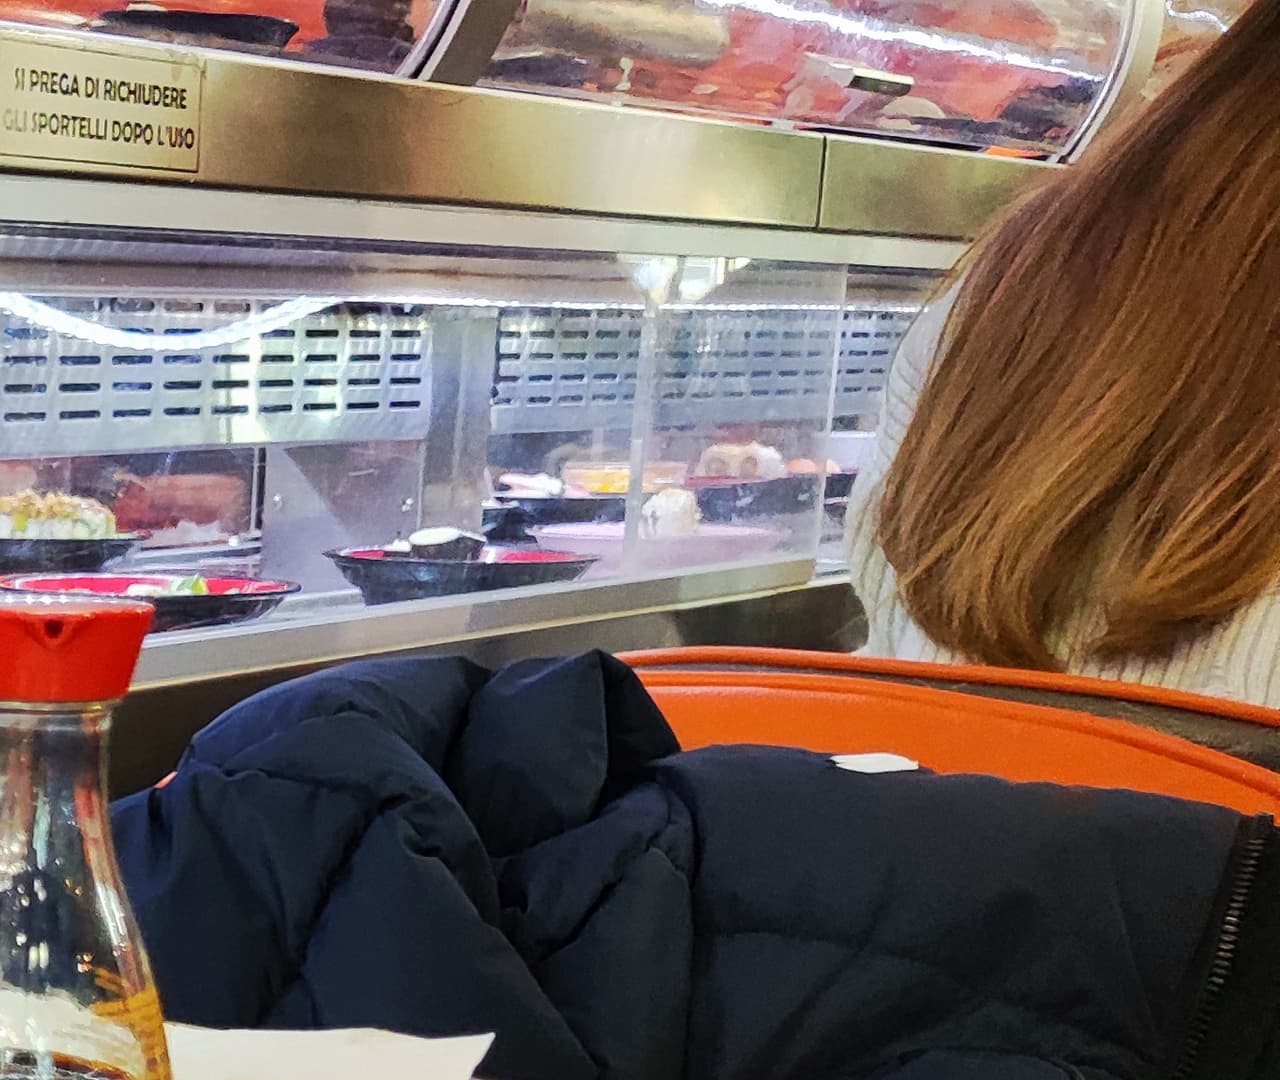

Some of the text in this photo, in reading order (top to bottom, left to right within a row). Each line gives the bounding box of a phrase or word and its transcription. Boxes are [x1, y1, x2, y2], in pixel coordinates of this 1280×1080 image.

[15, 67, 188, 110] SI PREGA DI RICHIUDERE
[2, 108, 196, 150] GLI SPORTELLI DOPO L'USO
